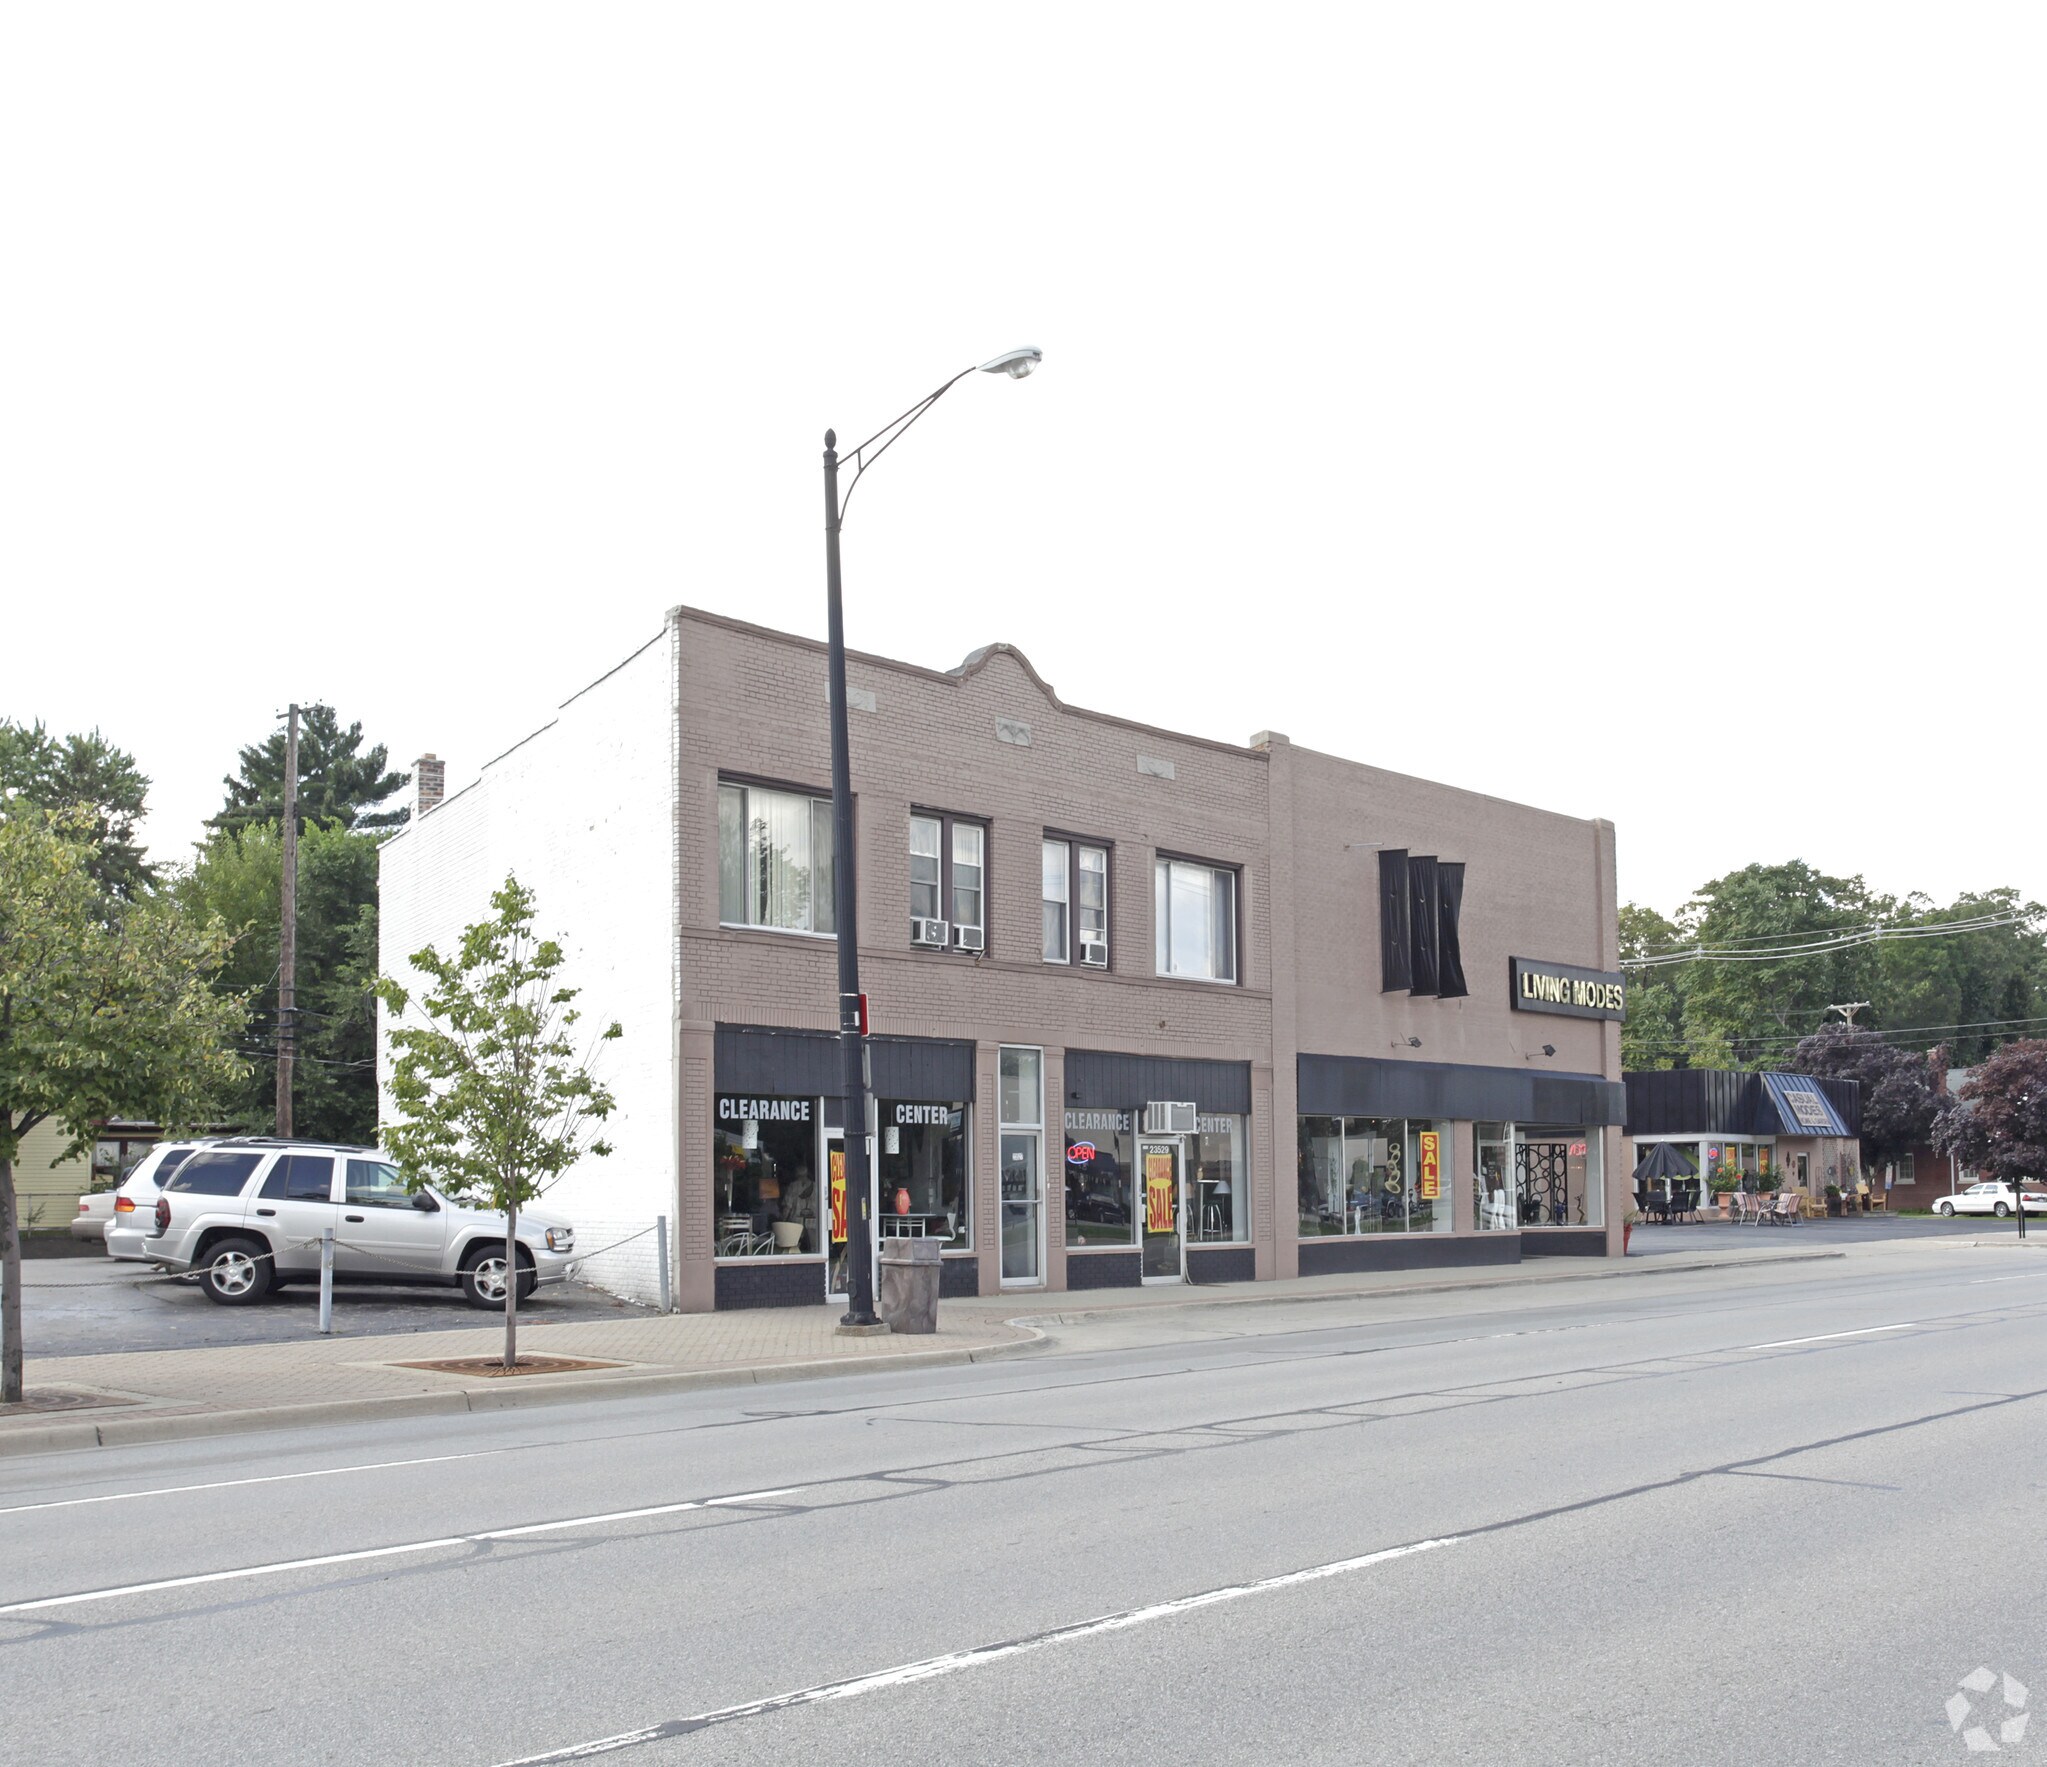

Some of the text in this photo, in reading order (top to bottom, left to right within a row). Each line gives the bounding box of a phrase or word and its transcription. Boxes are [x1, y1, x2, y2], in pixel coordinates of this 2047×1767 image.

[1522, 972, 1624, 1011] LIVING MODES
[1786, 1092, 1819, 1104] CASUAL
[719, 1098, 810, 1121] CLEARANCE
[896, 1103, 948, 1125] CENTER
[1794, 1104, 1824, 1116] MODES
[1064, 1111, 1130, 1131] CLEARANCE
[1196, 1116, 1233, 1134] CENTER
[1067, 1145, 1095, 1160] OPEN
[1149, 1145, 1169, 1154] 23529
[1423, 1136, 1437, 1195] SALE
[832, 1187, 848, 1239] SA
[1149, 1184, 1173, 1230] SALE
